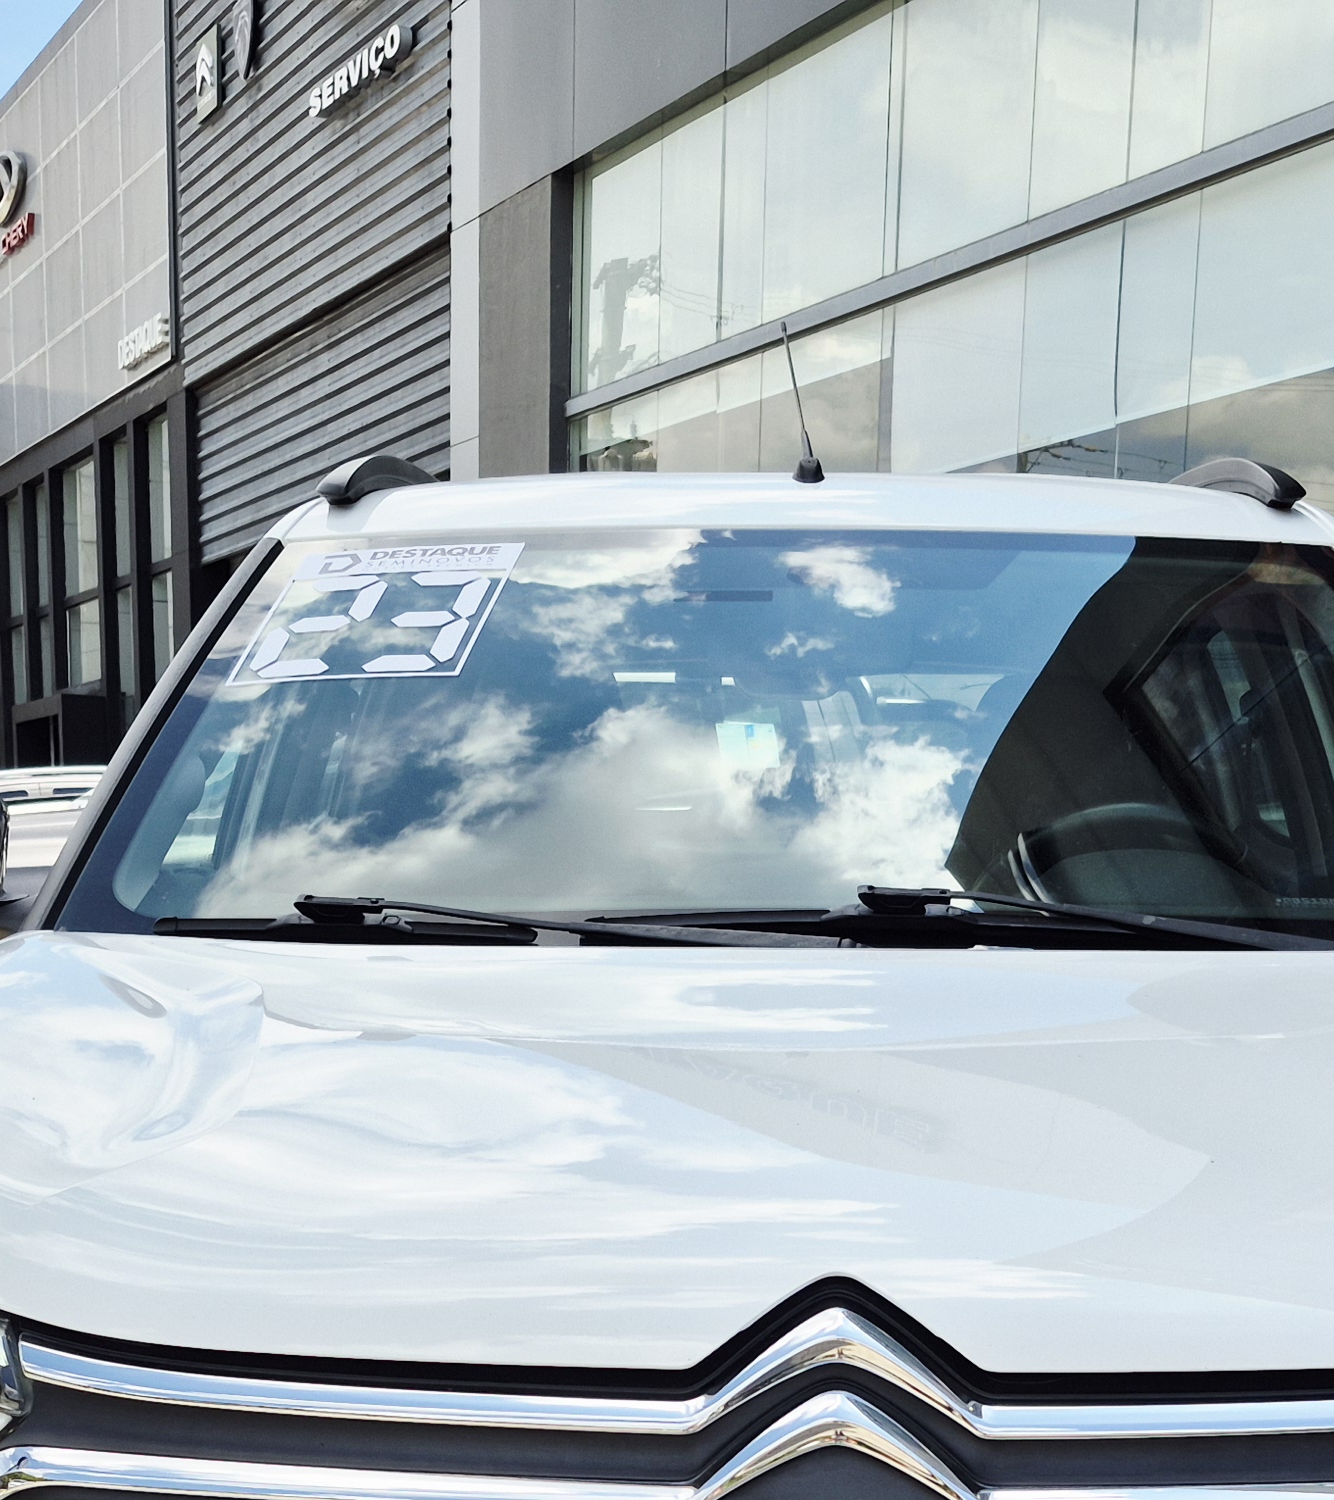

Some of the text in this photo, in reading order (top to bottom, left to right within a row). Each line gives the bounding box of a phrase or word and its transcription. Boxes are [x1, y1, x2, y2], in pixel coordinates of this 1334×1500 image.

[308, 24, 403, 117] SERVIÇO
[1, 211, 31, 255] CHERY
[366, 556, 496, 568] SEMINOVOS
[369, 546, 502, 561] DESTAQUE
[249, 570, 491, 679] 23
